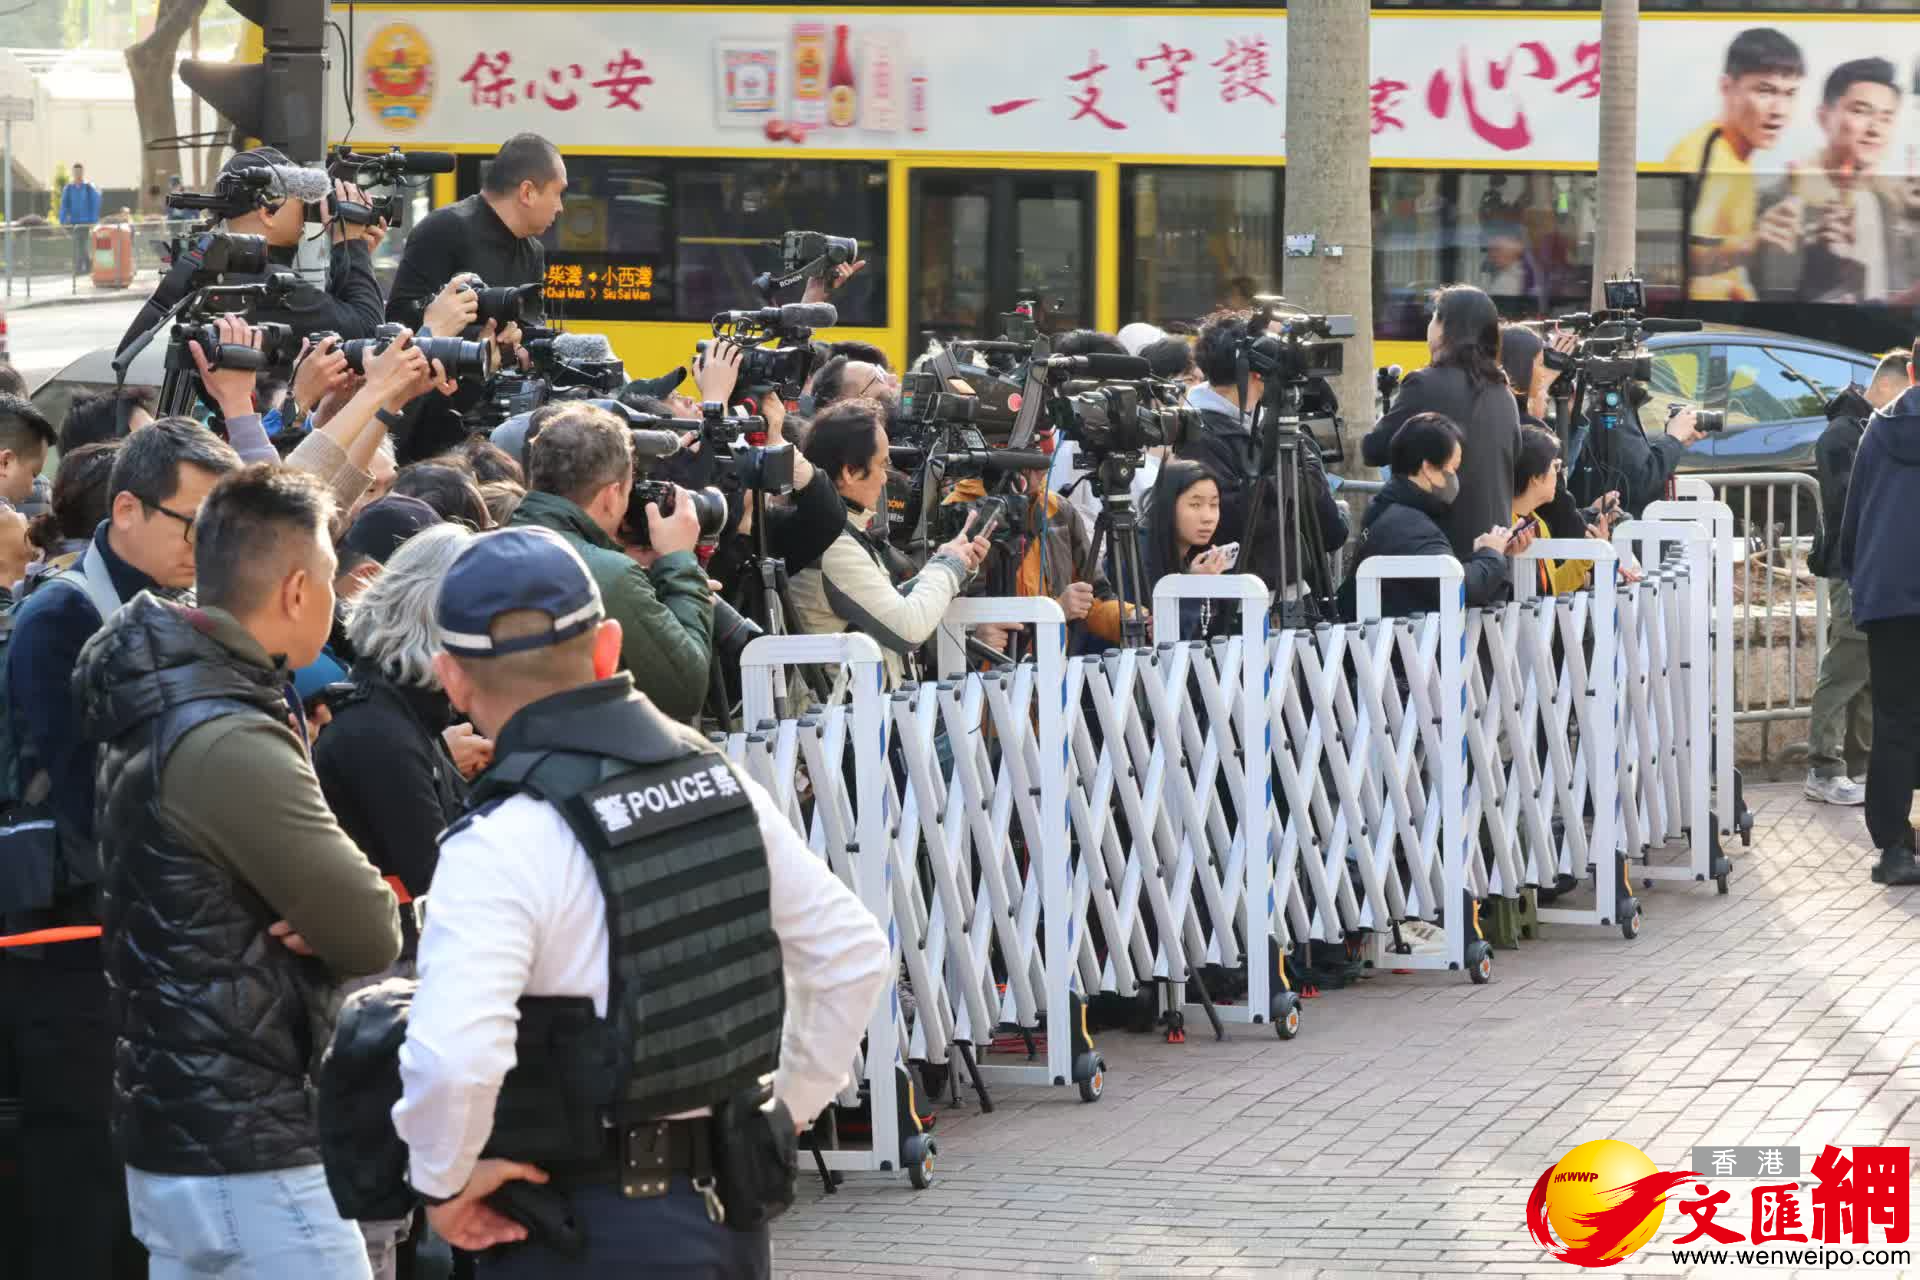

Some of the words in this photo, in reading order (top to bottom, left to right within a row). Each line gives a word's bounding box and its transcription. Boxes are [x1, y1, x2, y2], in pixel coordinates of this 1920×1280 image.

[460, 48, 653, 111] 保心安
[601, 264, 652, 288] 小西灣
